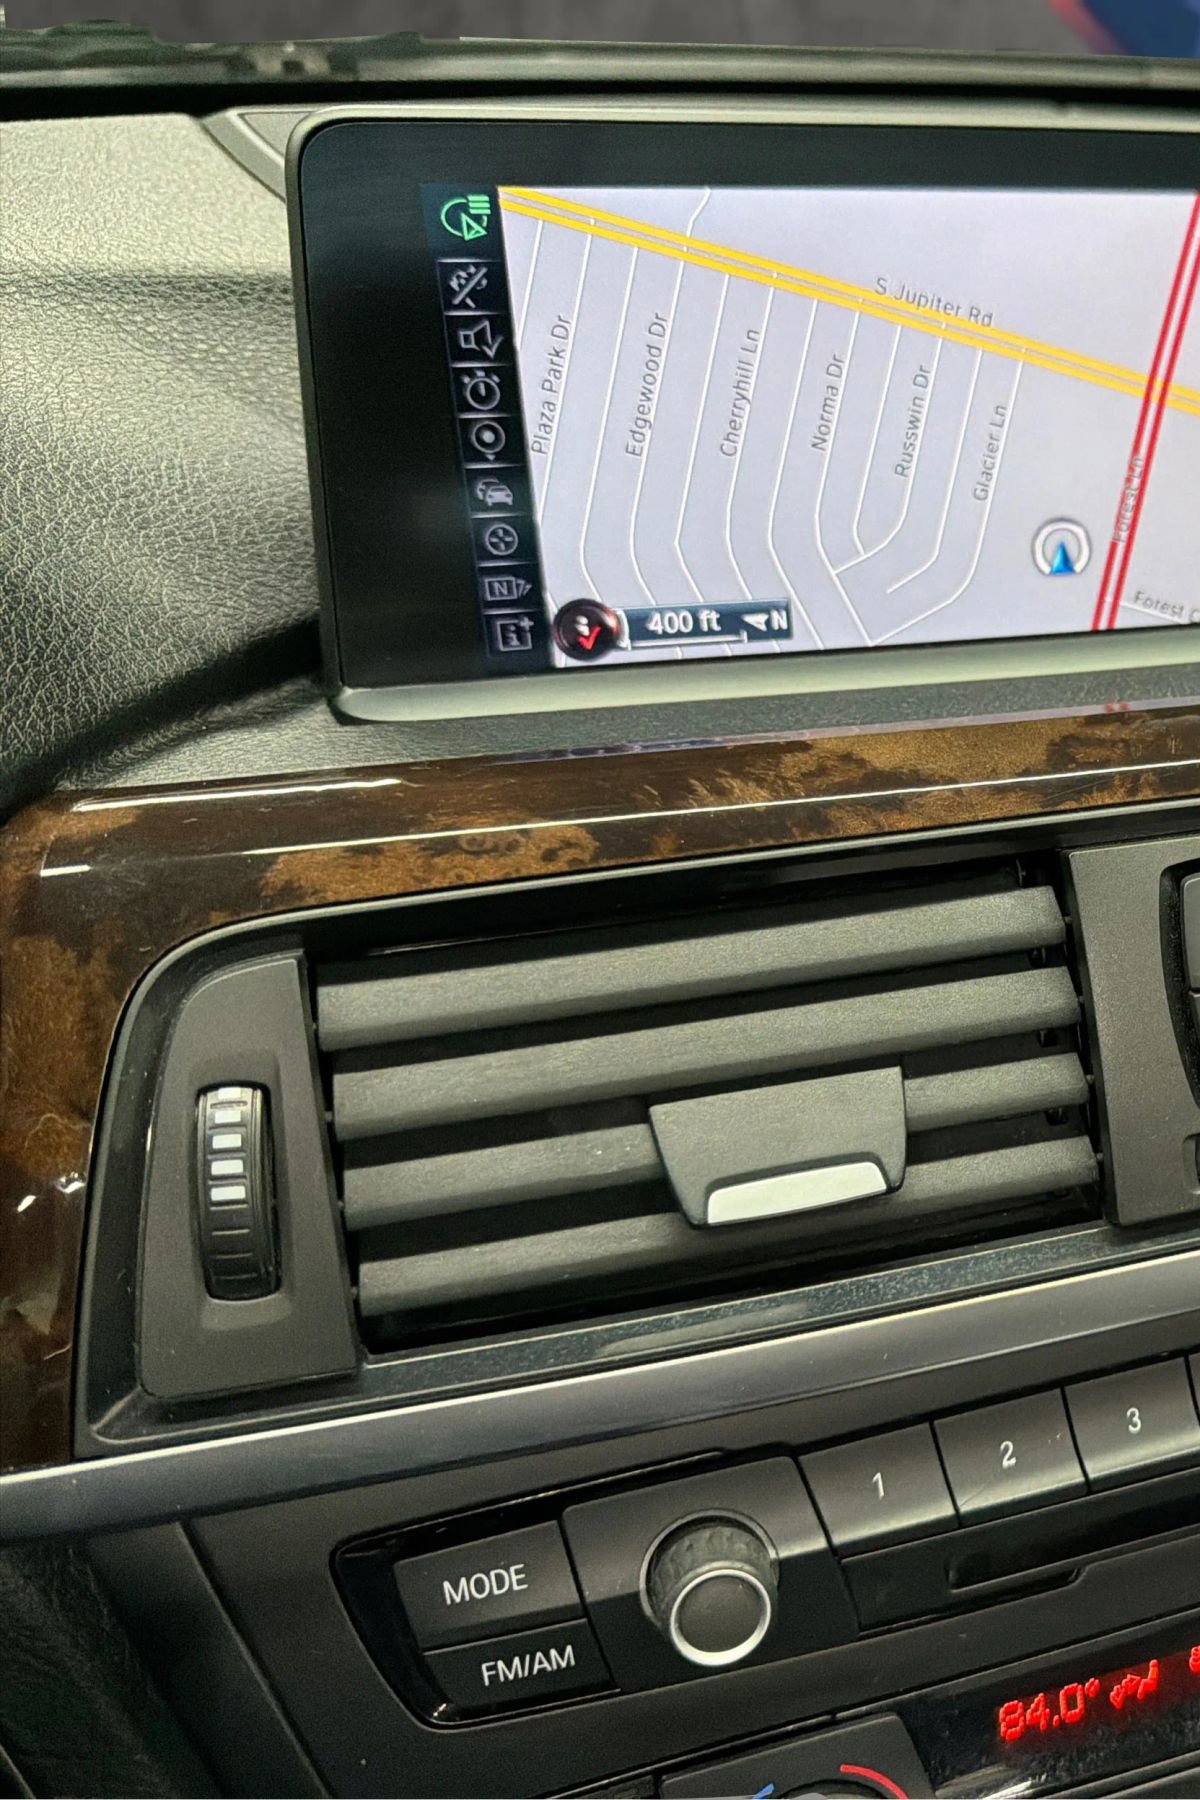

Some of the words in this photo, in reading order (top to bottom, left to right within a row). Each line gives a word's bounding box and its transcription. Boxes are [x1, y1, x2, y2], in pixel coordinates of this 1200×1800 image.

[875, 277, 888, 297] S
[892, 283, 962, 319] Jupiter
[968, 306, 994, 328] Rd
[551, 314, 573, 339] Dr
[541, 348, 567, 396] Park
[625, 343, 661, 458] Edgewood
[648, 312, 670, 340] Dr
[719, 357, 755, 458] Cherryhill
[740, 328, 761, 355] Ln
[811, 386, 840, 452] Norma
[828, 353, 847, 379] Dr
[894, 394, 924, 479] Russwin
[912, 364, 932, 389] Dr
[531, 401, 557, 456] Plaza
[972, 434, 1001, 502] Glacier
[987, 404, 1008, 429] Ln
[647, 612, 693, 635] 400
[700, 610, 721, 632] ft
[770, 609, 789, 631] N
[1134, 590, 1185, 619] Forest
[1126, 1406, 1143, 1434] 3
[999, 1440, 1017, 1469] 2
[871, 1471, 886, 1499] 1
[442, 1563, 529, 1606] MODE
[481, 1644, 577, 1687] FM/AM
